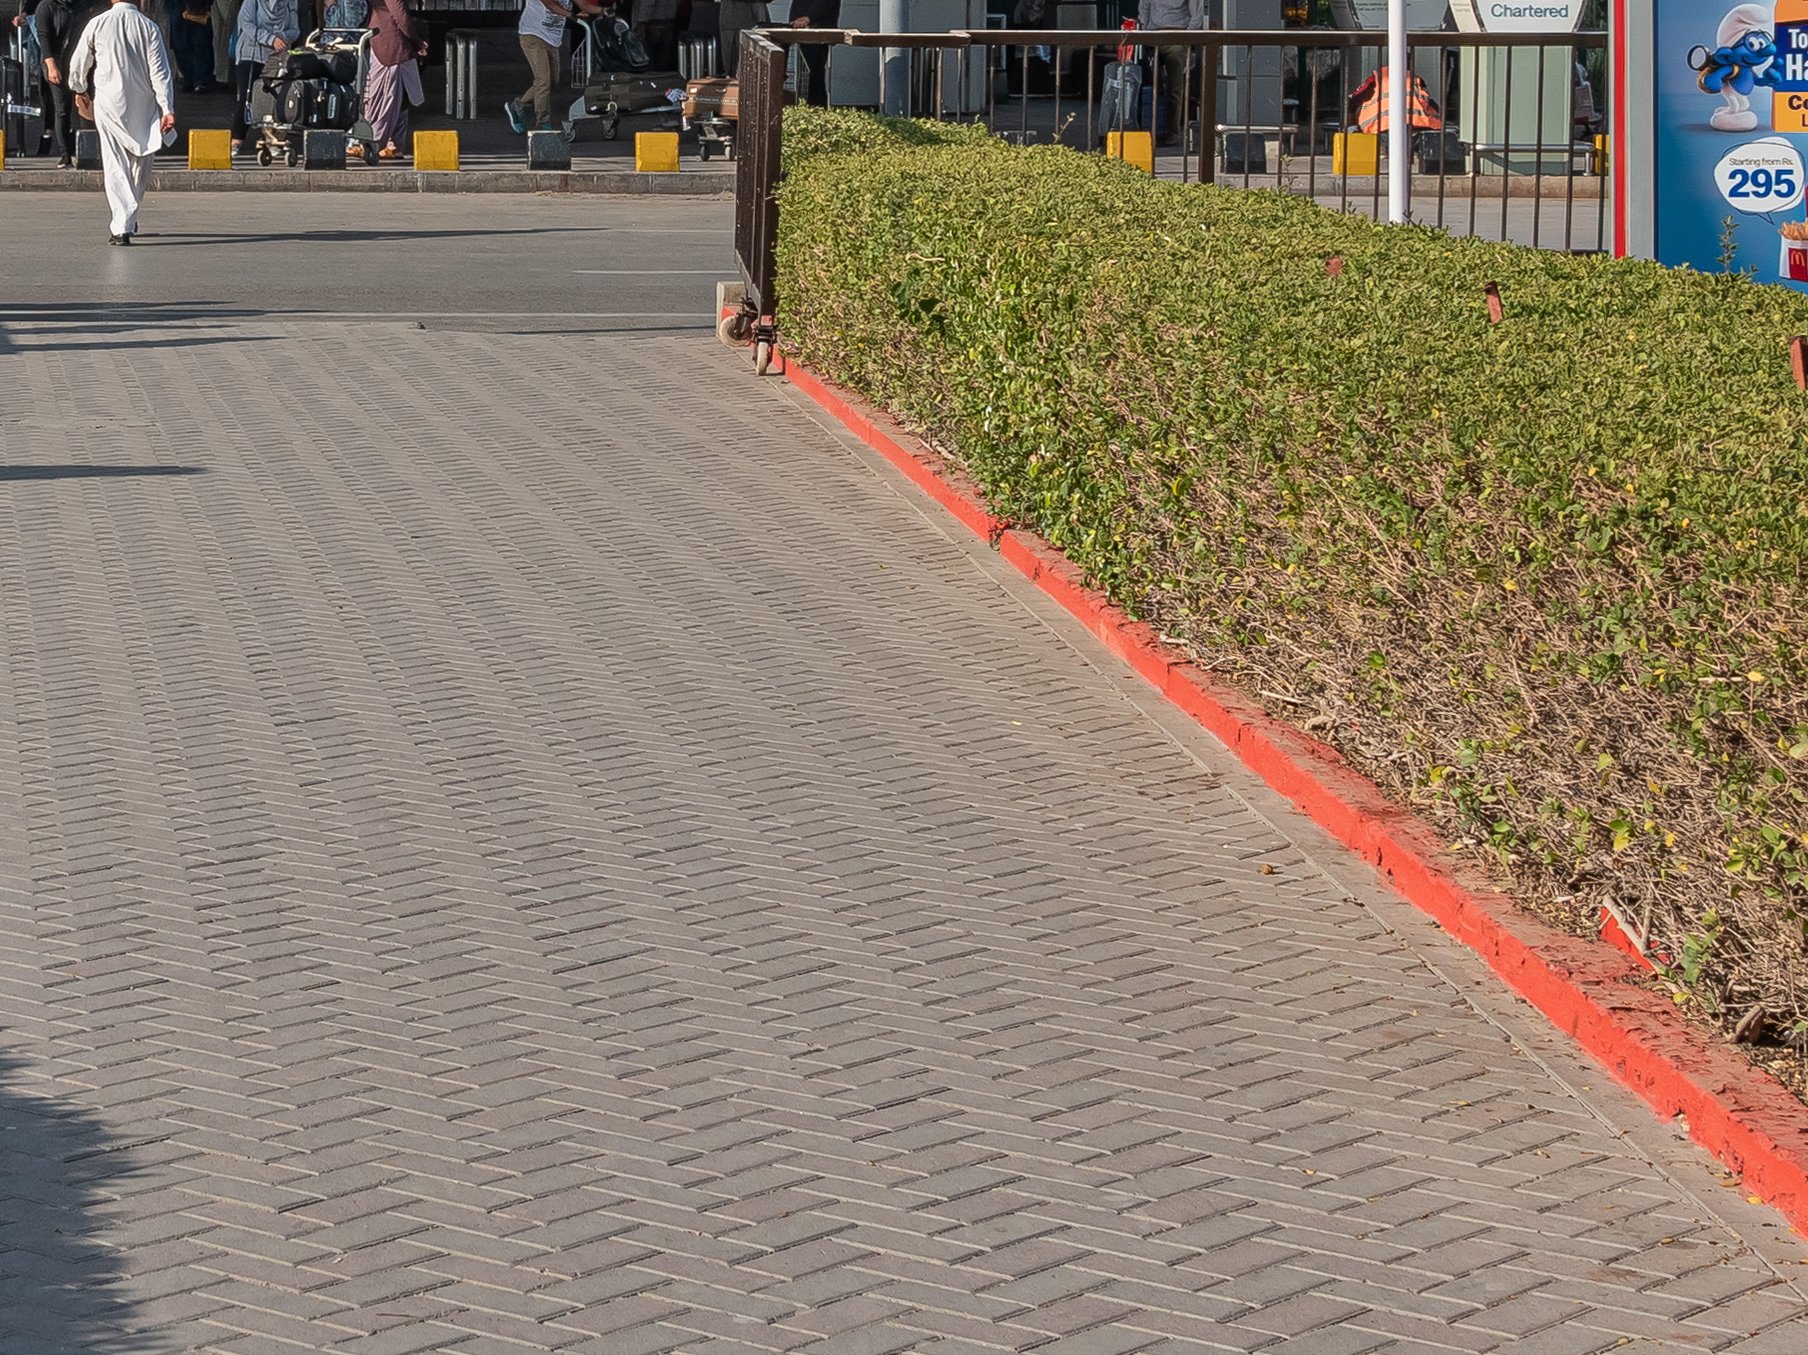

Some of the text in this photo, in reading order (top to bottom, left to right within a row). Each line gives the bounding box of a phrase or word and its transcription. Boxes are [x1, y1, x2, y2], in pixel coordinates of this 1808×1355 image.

[1490, 3, 1569, 18] Chartered
[1728, 157, 1794, 169] Starting from Rs.
[1727, 168, 1797, 199] 295
